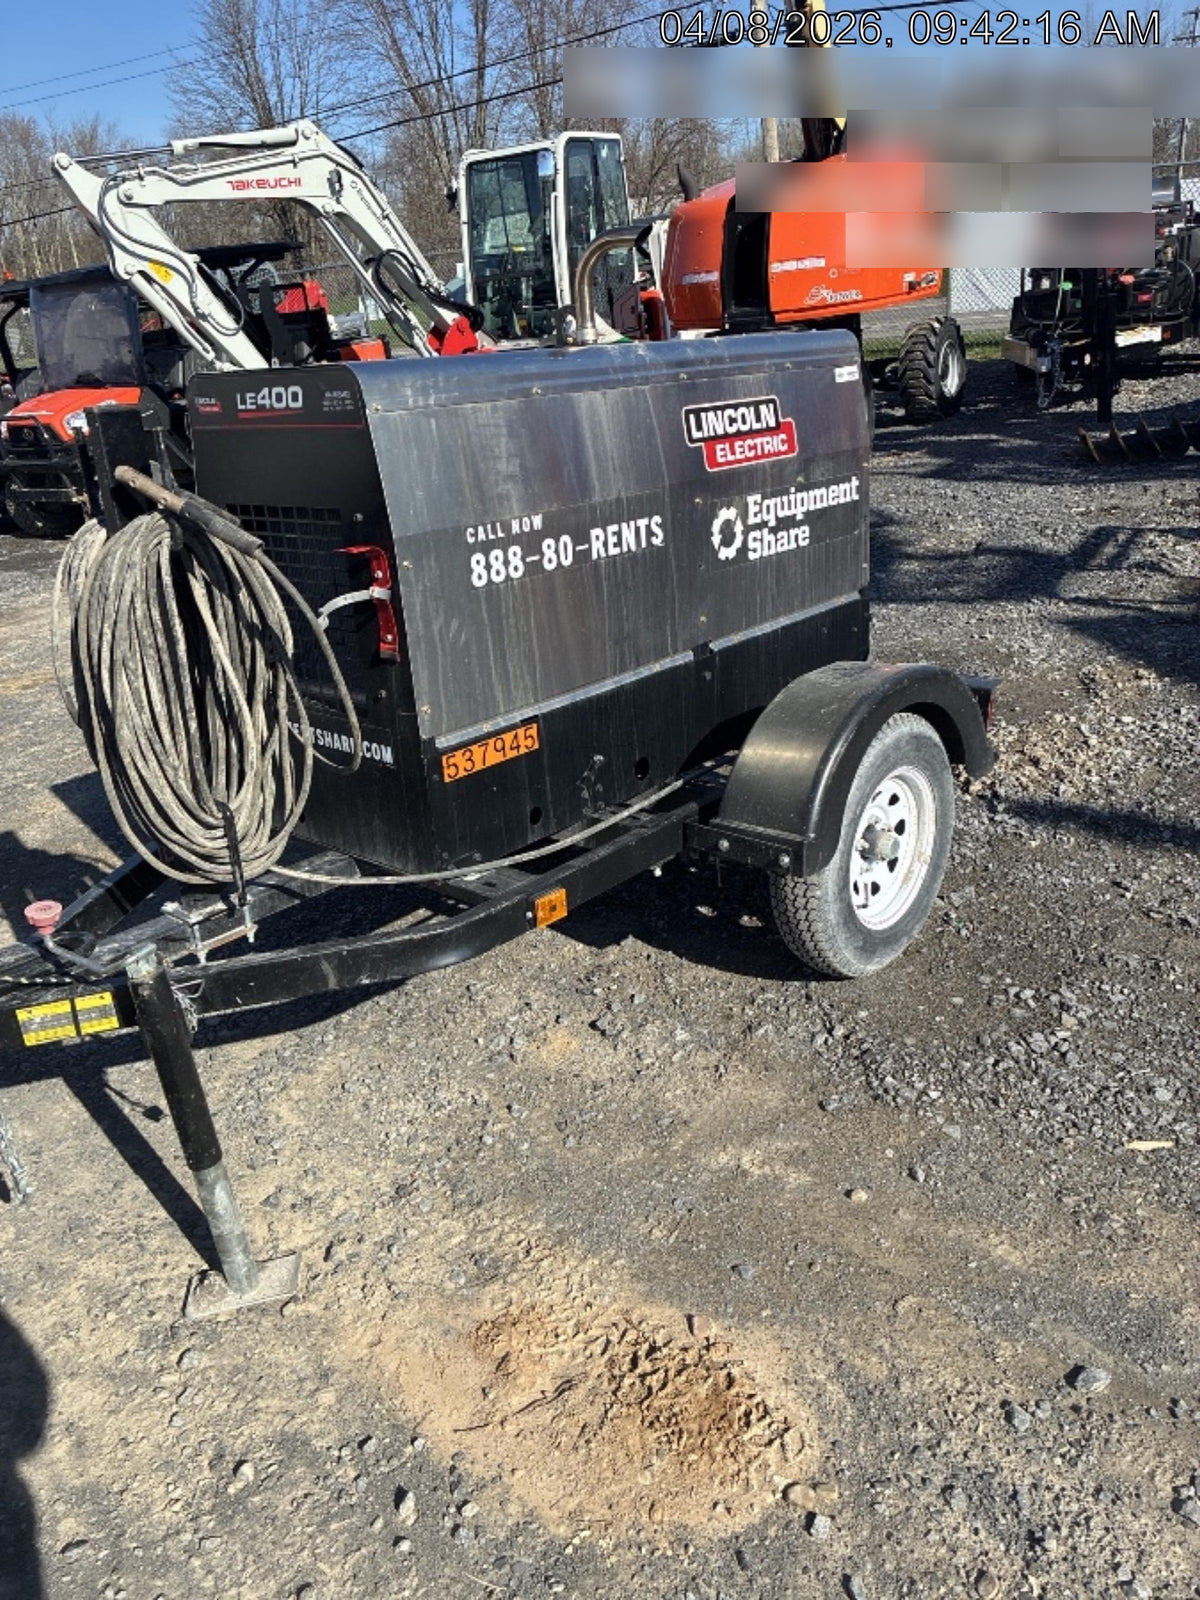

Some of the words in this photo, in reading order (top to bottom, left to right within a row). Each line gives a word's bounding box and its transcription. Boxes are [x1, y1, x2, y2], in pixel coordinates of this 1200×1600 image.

[236, 385, 303, 410] LE400
[688, 403, 776, 440] LINCOLN
[715, 433, 789, 463] ELECTRIC
[746, 476, 860, 528] Equipment
[466, 522, 505, 544] CALL
[511, 513, 544, 535] NOW
[747, 524, 810, 561] Share
[470, 514, 665, 588] 888-80-RENTS
[444, 726, 536, 779] 537945
